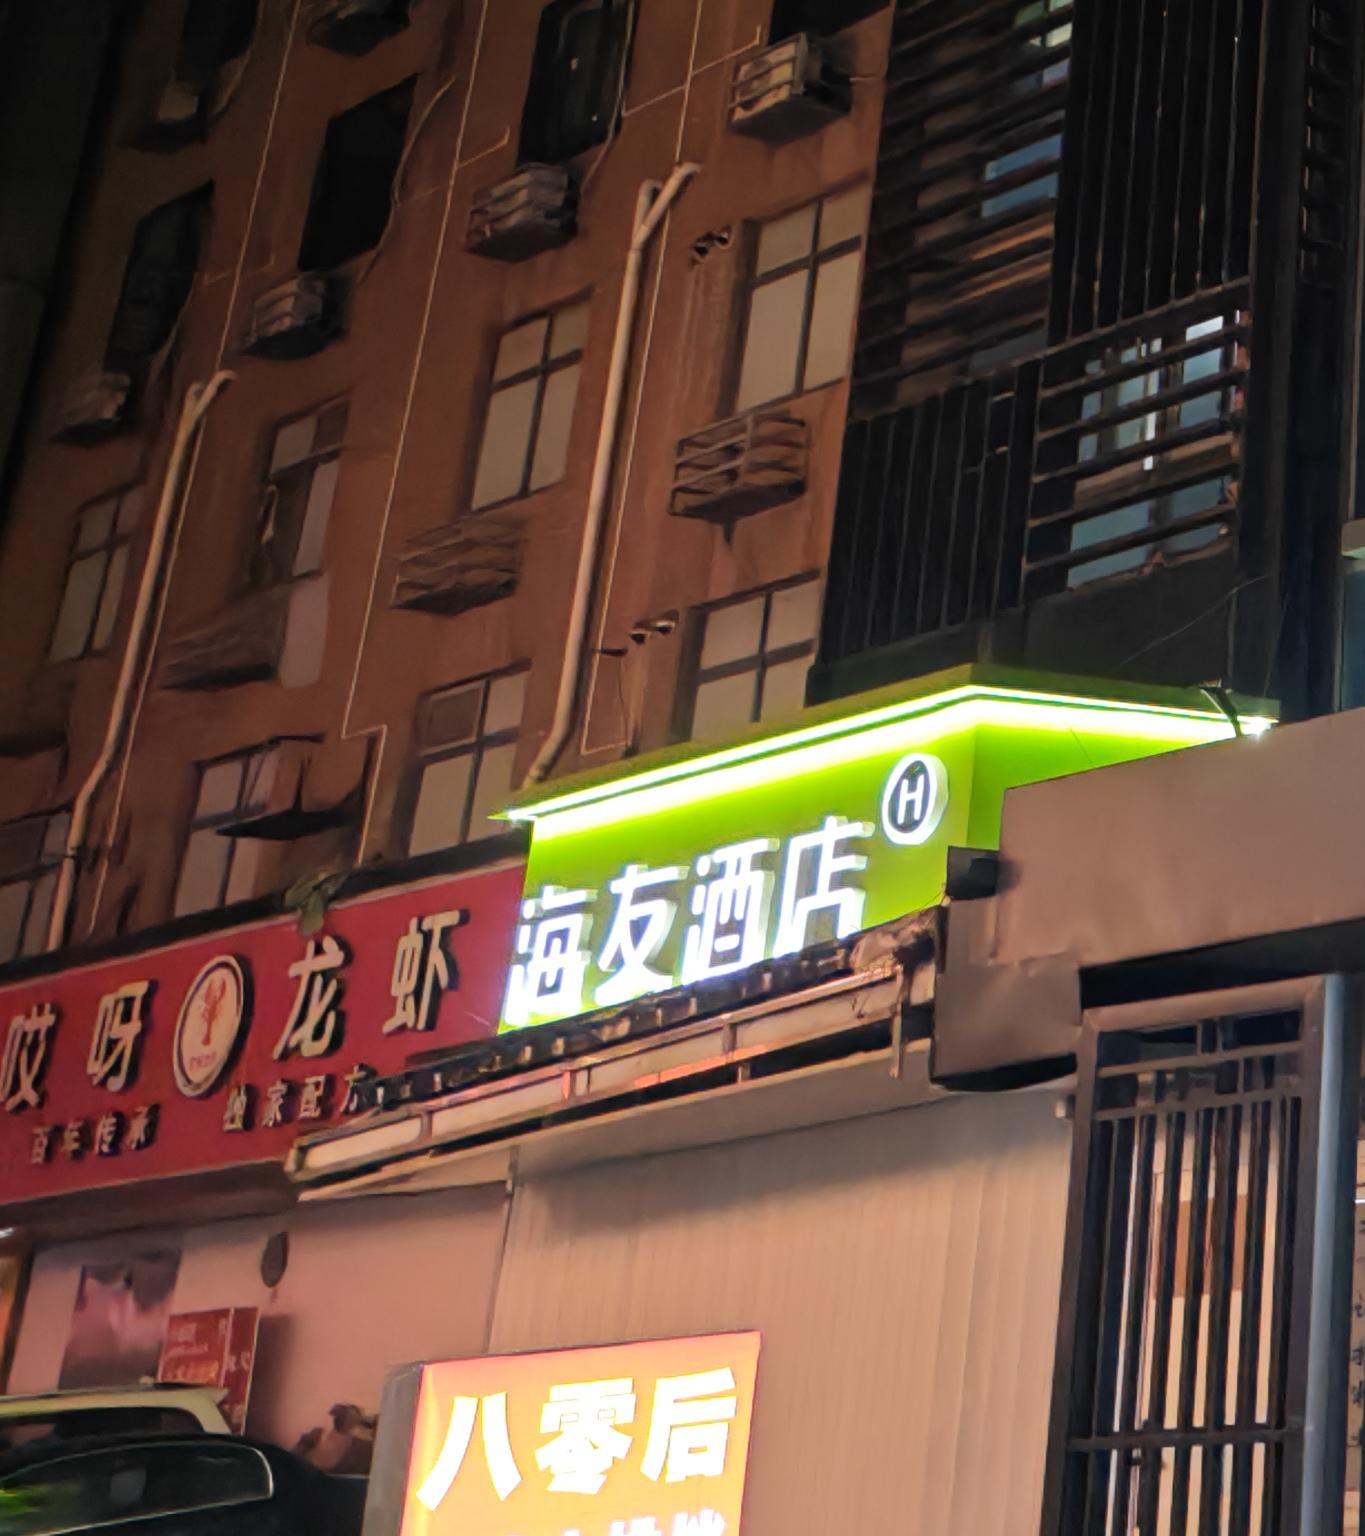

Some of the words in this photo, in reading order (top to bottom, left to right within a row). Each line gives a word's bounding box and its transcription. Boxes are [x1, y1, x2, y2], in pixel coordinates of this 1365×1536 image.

[272, 909, 462, 1061] 龙虾
[503, 815, 872, 1026] 海友酒店
[415, 1366, 737, 1512] 八零后
